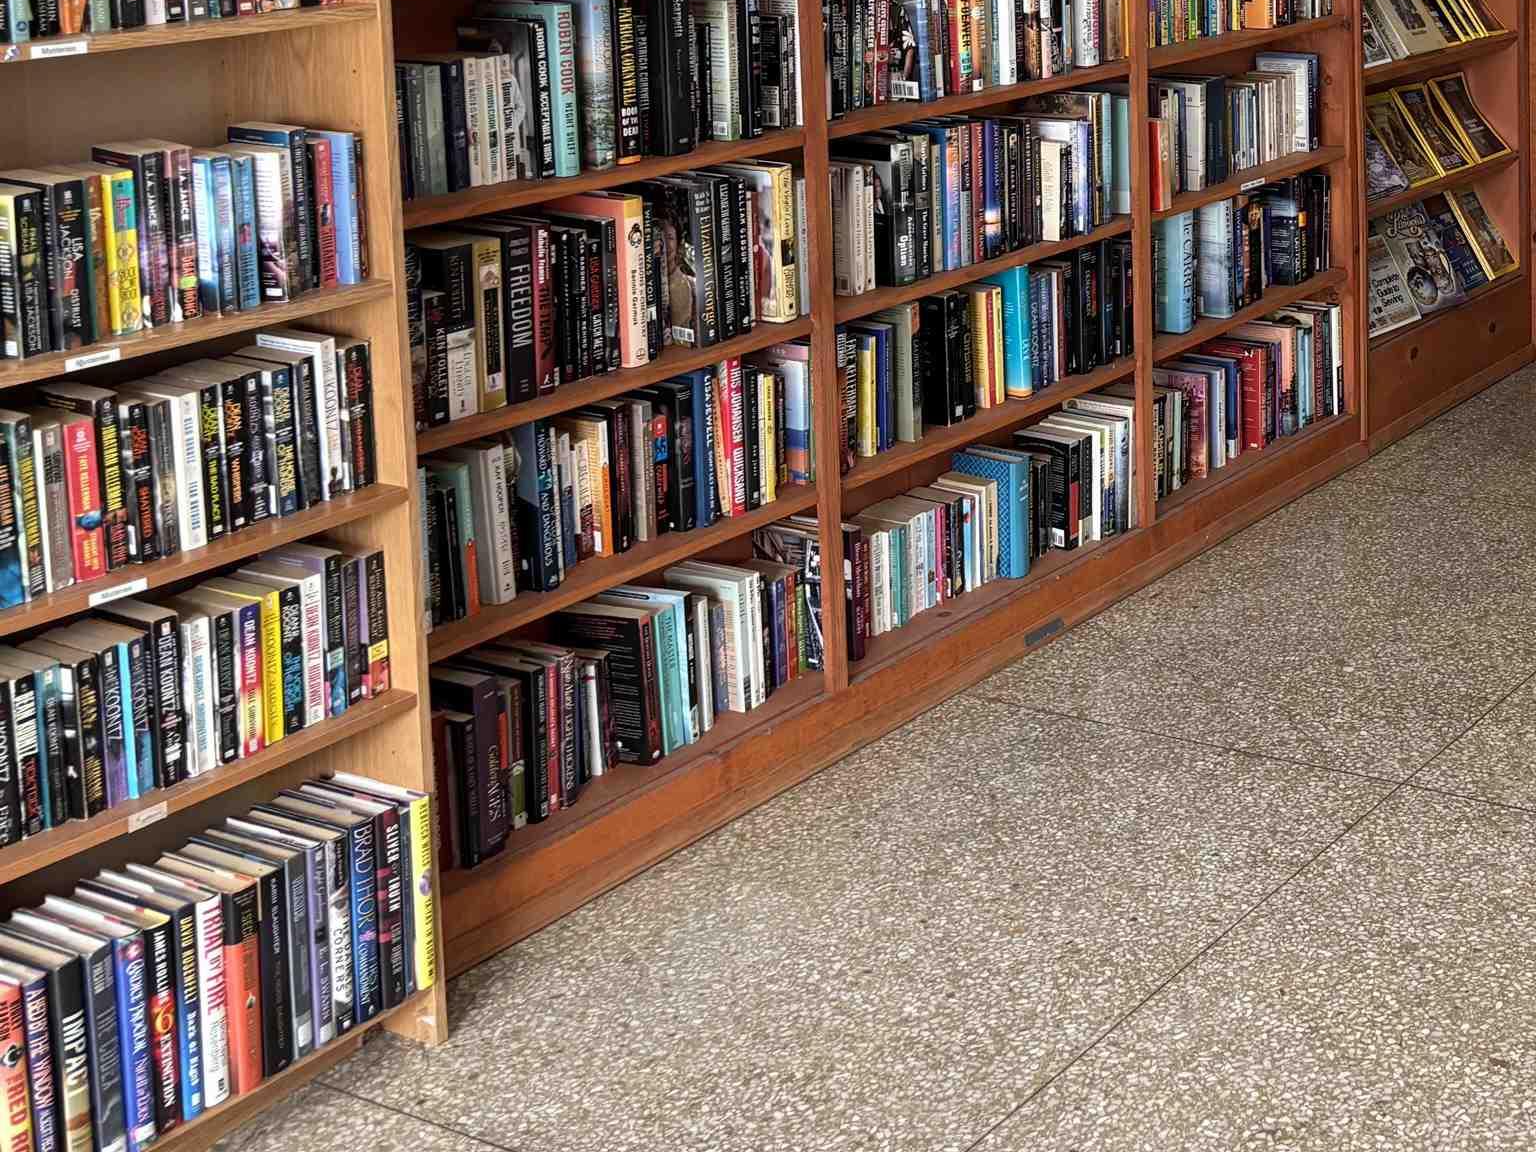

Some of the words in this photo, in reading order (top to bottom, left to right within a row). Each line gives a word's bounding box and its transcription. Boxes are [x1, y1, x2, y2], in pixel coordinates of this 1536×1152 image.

[535, 27, 549, 55] ROBIN
[557, 11, 573, 56] ROBIN
[617, 7, 634, 50] PATRICIA
[867, 16, 876, 48] CUSSLER
[960, 7, 971, 47] DEAVER
[537, 57, 551, 88] COOK
[560, 59, 574, 95] COOK
[619, 53, 636, 106] CORNWELL
[541, 91, 552, 140] ACCEPTABLE
[565, 102, 575, 126] NIGHT
[543, 142, 553, 164] RISK
[566, 133, 576, 157] SHIFT
[146, 190, 158, 226] JANCE
[180, 186, 190, 221] JANCE
[737, 183, 747, 223] WILLIAM
[60, 224, 75, 280] JACKSON
[72, 238, 84, 262] LISA
[698, 216, 716, 279] Elizabeth
[739, 227, 749, 264] GIBSON
[899, 235, 910, 267] Option
[509, 264, 533, 349] FREEDOM
[701, 282, 718, 327] George
[436, 328, 446, 346] KEN
[437, 349, 448, 399] FOLLETT
[704, 374, 713, 398] LISA
[732, 367, 742, 387] IRIS
[846, 364, 857, 418] KELLERMAN
[324, 382, 339, 432] KOONTZ
[705, 401, 714, 447] JEWELL
[731, 391, 744, 444] JOHANSEN
[102, 425, 118, 464] JONATHAN
[105, 466, 122, 510] KELLERMAN
[733, 447, 746, 504] QUICKSAND
[157, 635, 175, 666] DEAN
[244, 619, 256, 646] DEAN
[245, 648, 257, 684] KOONTZ
[16, 693, 36, 721] DEAN
[159, 668, 177, 713] KOONTZ
[105, 687, 120, 740] KOONTZ
[19, 723, 38, 757] KOONTZ
[354, 827, 375, 872] BRAD
[386, 824, 400, 863] SLIVER
[356, 879, 376, 927] THOR
[388, 878, 401, 912] TRUTH
[154, 930, 169, 961] JAMES
[180, 916, 194, 947] DAVID
[203, 906, 225, 950] TRIAL
[334, 929, 345, 993] CORNERS
[208, 974, 228, 1015] FIRE
[63, 1012, 88, 1099] IMPACT
[159, 1034, 176, 1107] EXTINCTION
